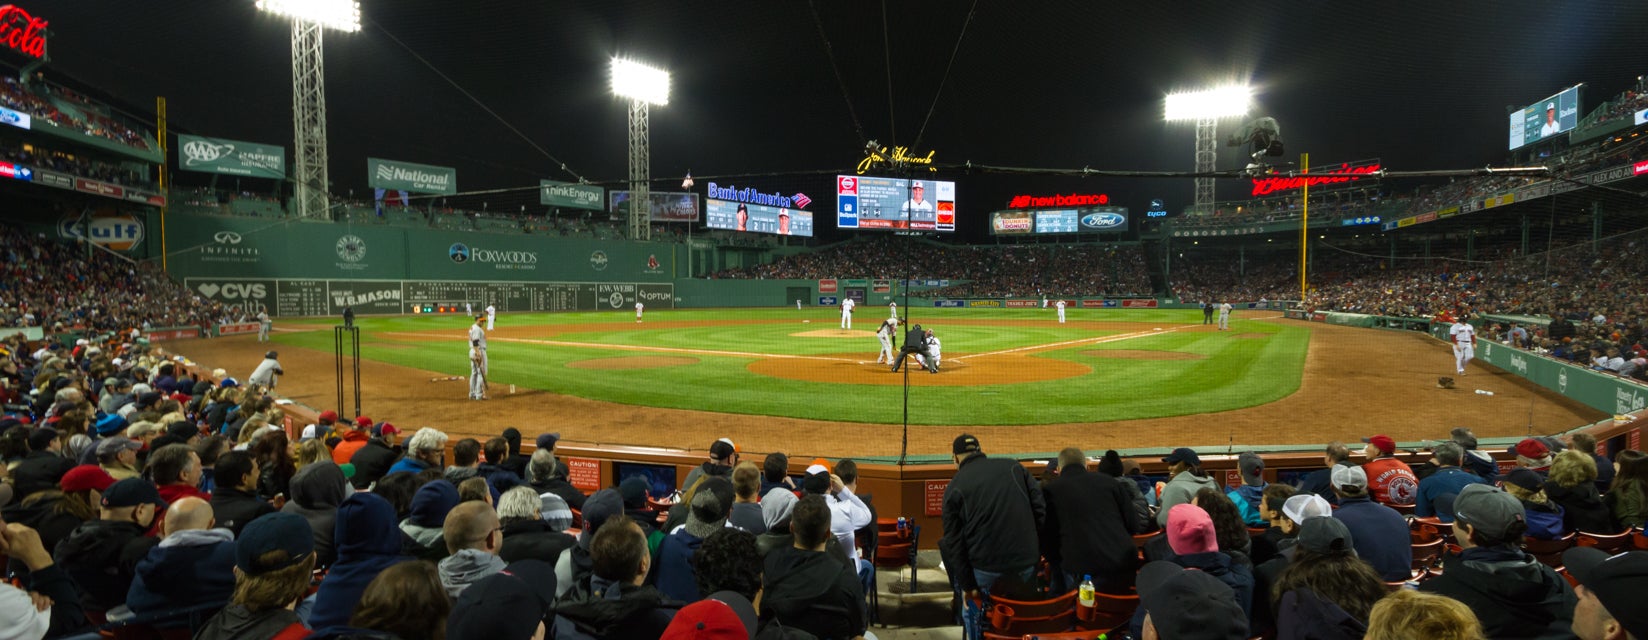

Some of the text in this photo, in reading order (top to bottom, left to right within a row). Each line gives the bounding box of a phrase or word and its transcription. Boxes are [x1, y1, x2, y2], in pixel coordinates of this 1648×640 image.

[187, 142, 219, 161] AAA
[393, 167, 450, 185] National
[1593, 173, 1607, 184] ALEX
[1608, 169, 1623, 180] AND
[708, 182, 792, 208] Bank of America
[1089, 214, 1116, 226] Ford
[1147, 210, 1167, 218] tyco
[64, 221, 138, 239] Gulf
[201, 247, 258, 255] INFINITI
[221, 283, 267, 299] CVS
[613, 285, 635, 293] WEBB
[646, 292, 671, 301] OPTUM
[569, 460, 599, 468] CAUTION!
